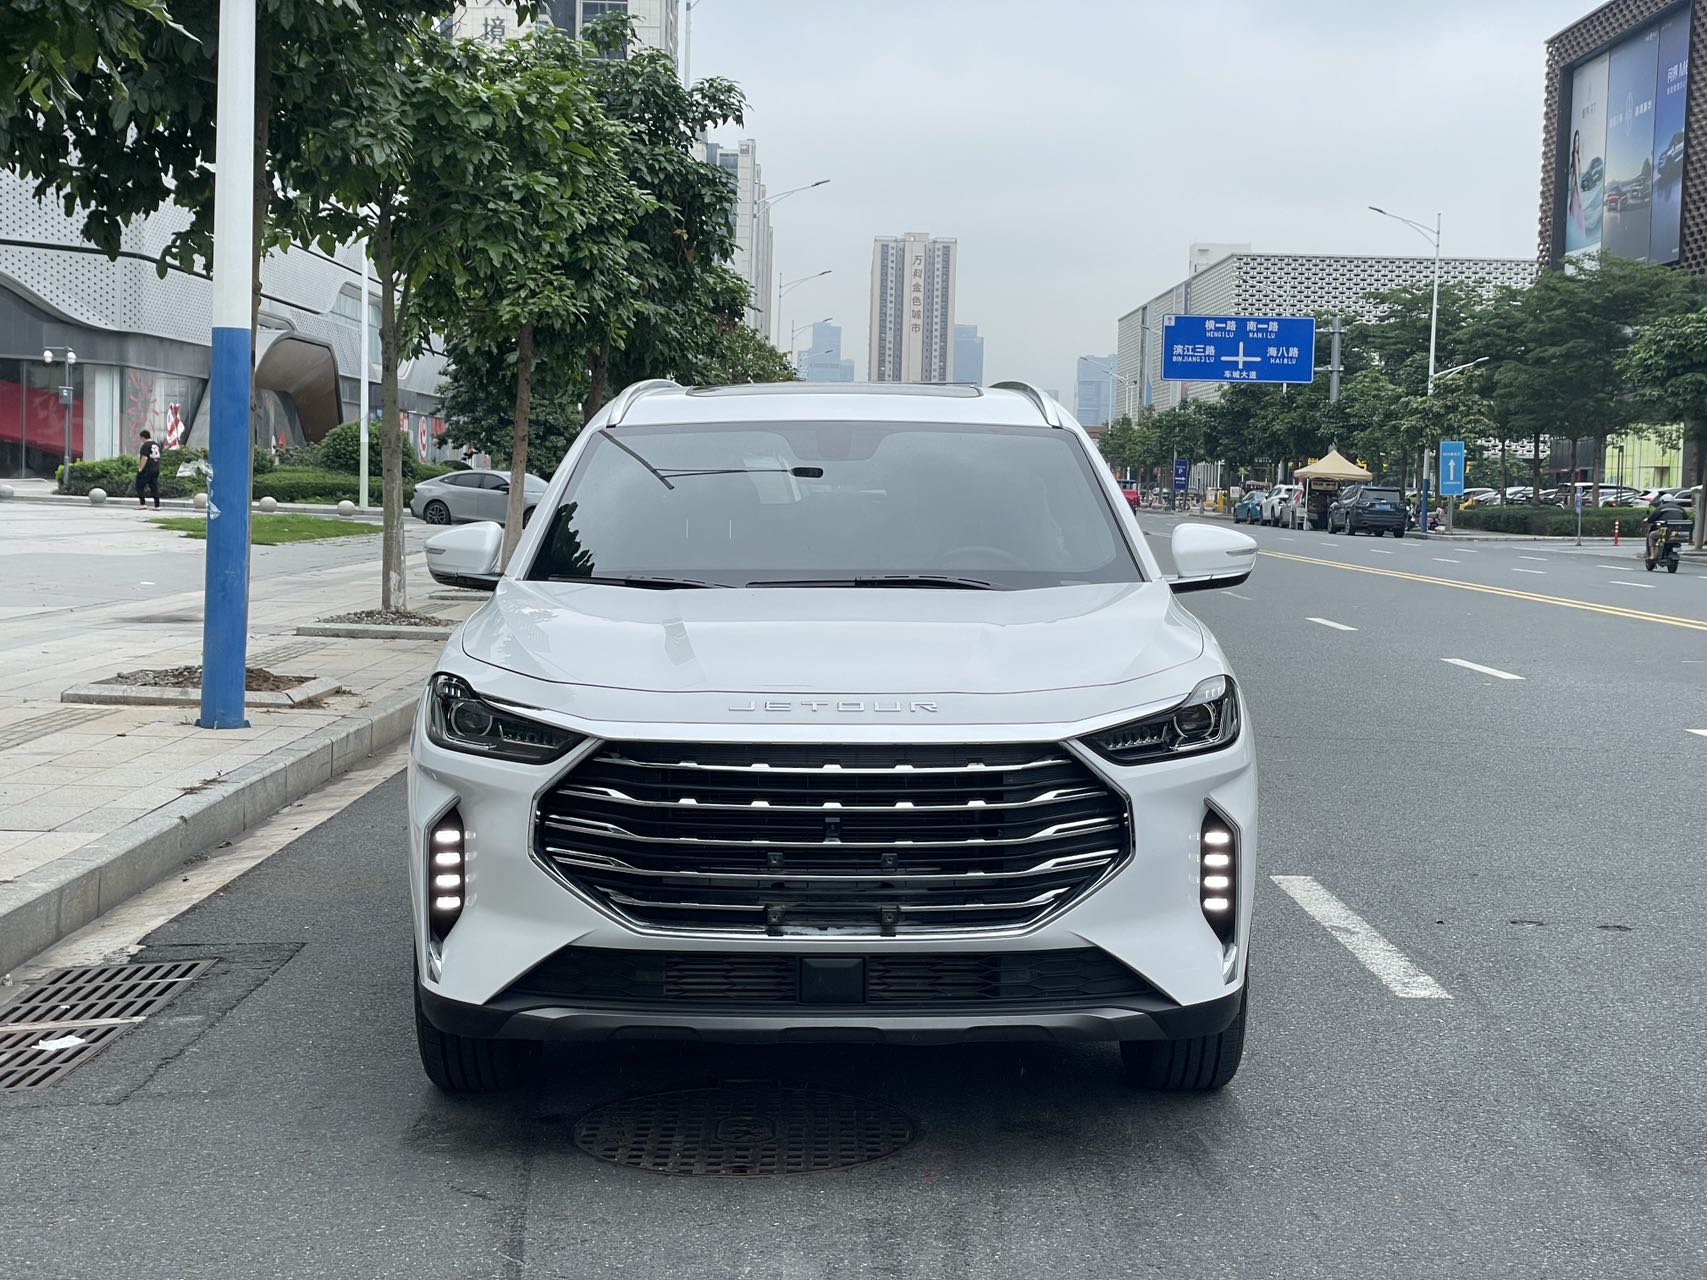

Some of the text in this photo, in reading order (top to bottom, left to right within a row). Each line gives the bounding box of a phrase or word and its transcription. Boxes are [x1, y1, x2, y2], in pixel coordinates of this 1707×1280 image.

[911, 255, 923, 333] 万科金色城市
[1204, 320, 1236, 331] 横一路
[1246, 320, 1279, 332] 南一路
[1172, 345, 1215, 356] 滨江三路
[1267, 347, 1299, 358] 海八路
[728, 700, 938, 712] JETOUR
